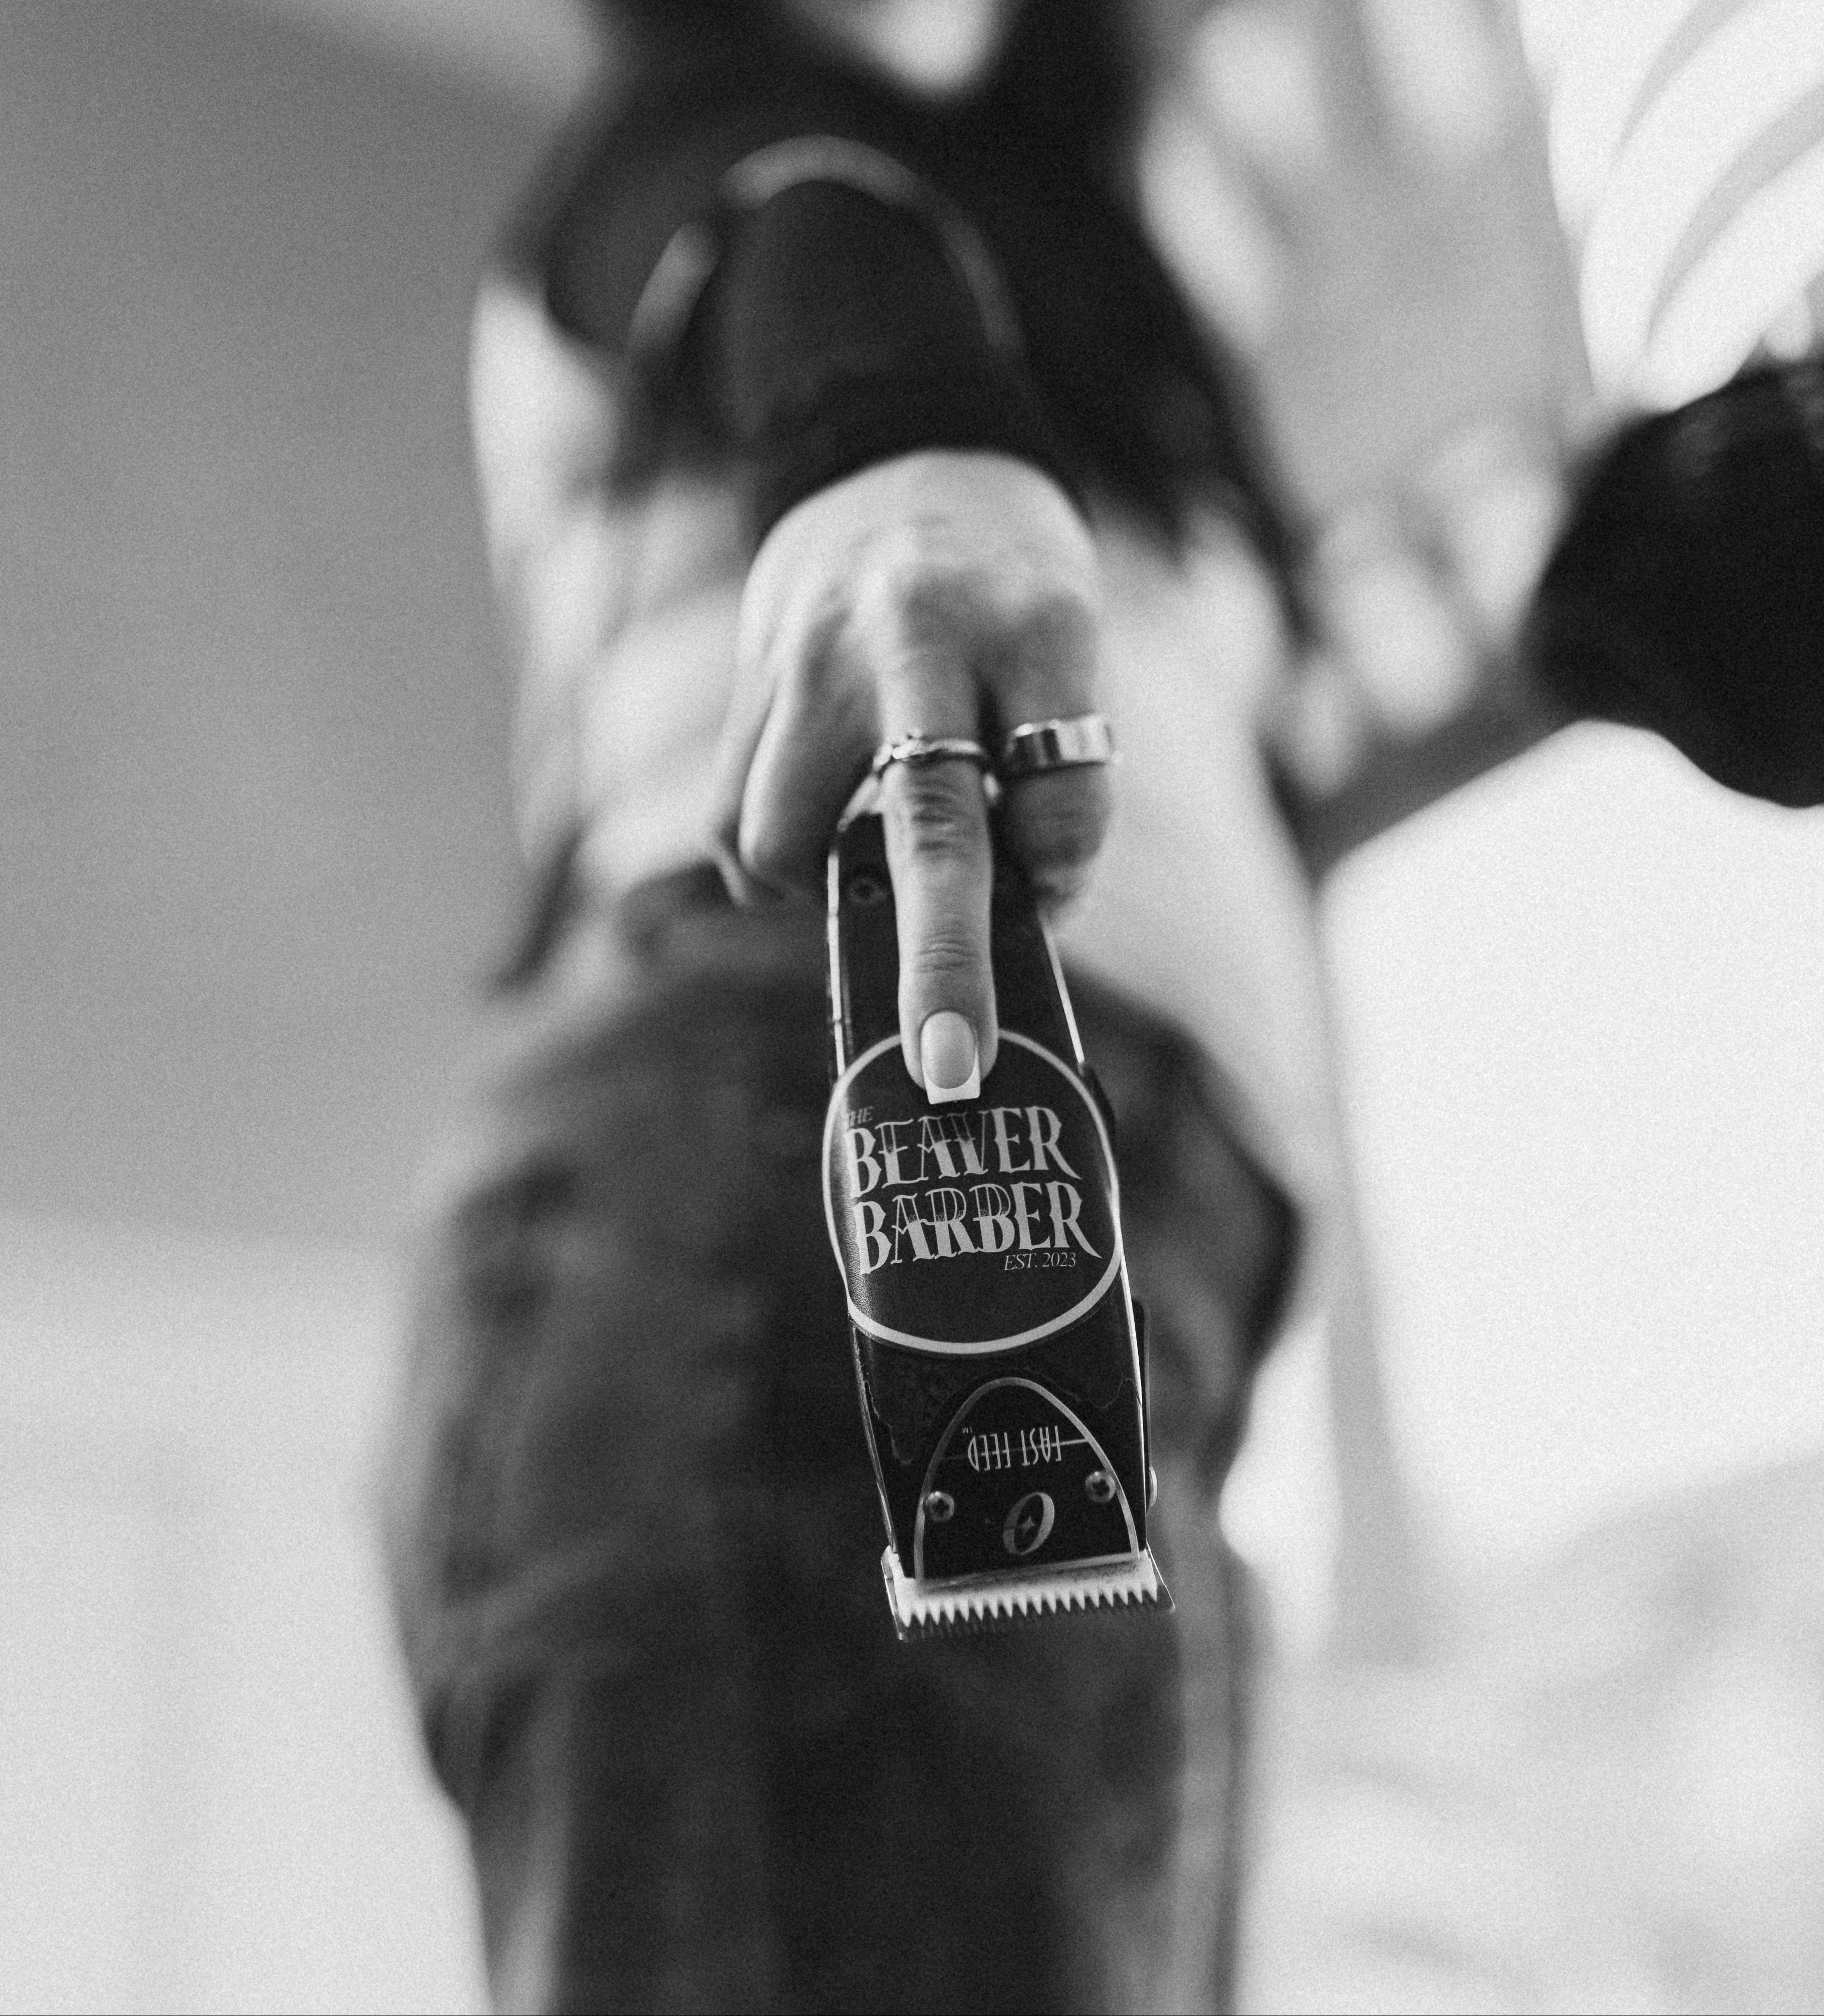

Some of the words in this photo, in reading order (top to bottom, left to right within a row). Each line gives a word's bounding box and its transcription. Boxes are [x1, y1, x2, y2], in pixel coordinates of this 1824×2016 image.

[846, 1106, 1083, 1198] BEAVER
[854, 1181, 1102, 1275] BARBER
[1004, 1253, 1037, 1270] EST.
[1042, 1252, 1076, 1267] 2023
[968, 1432, 1011, 1472] FEED
[1021, 1426, 1061, 1466] FAST
